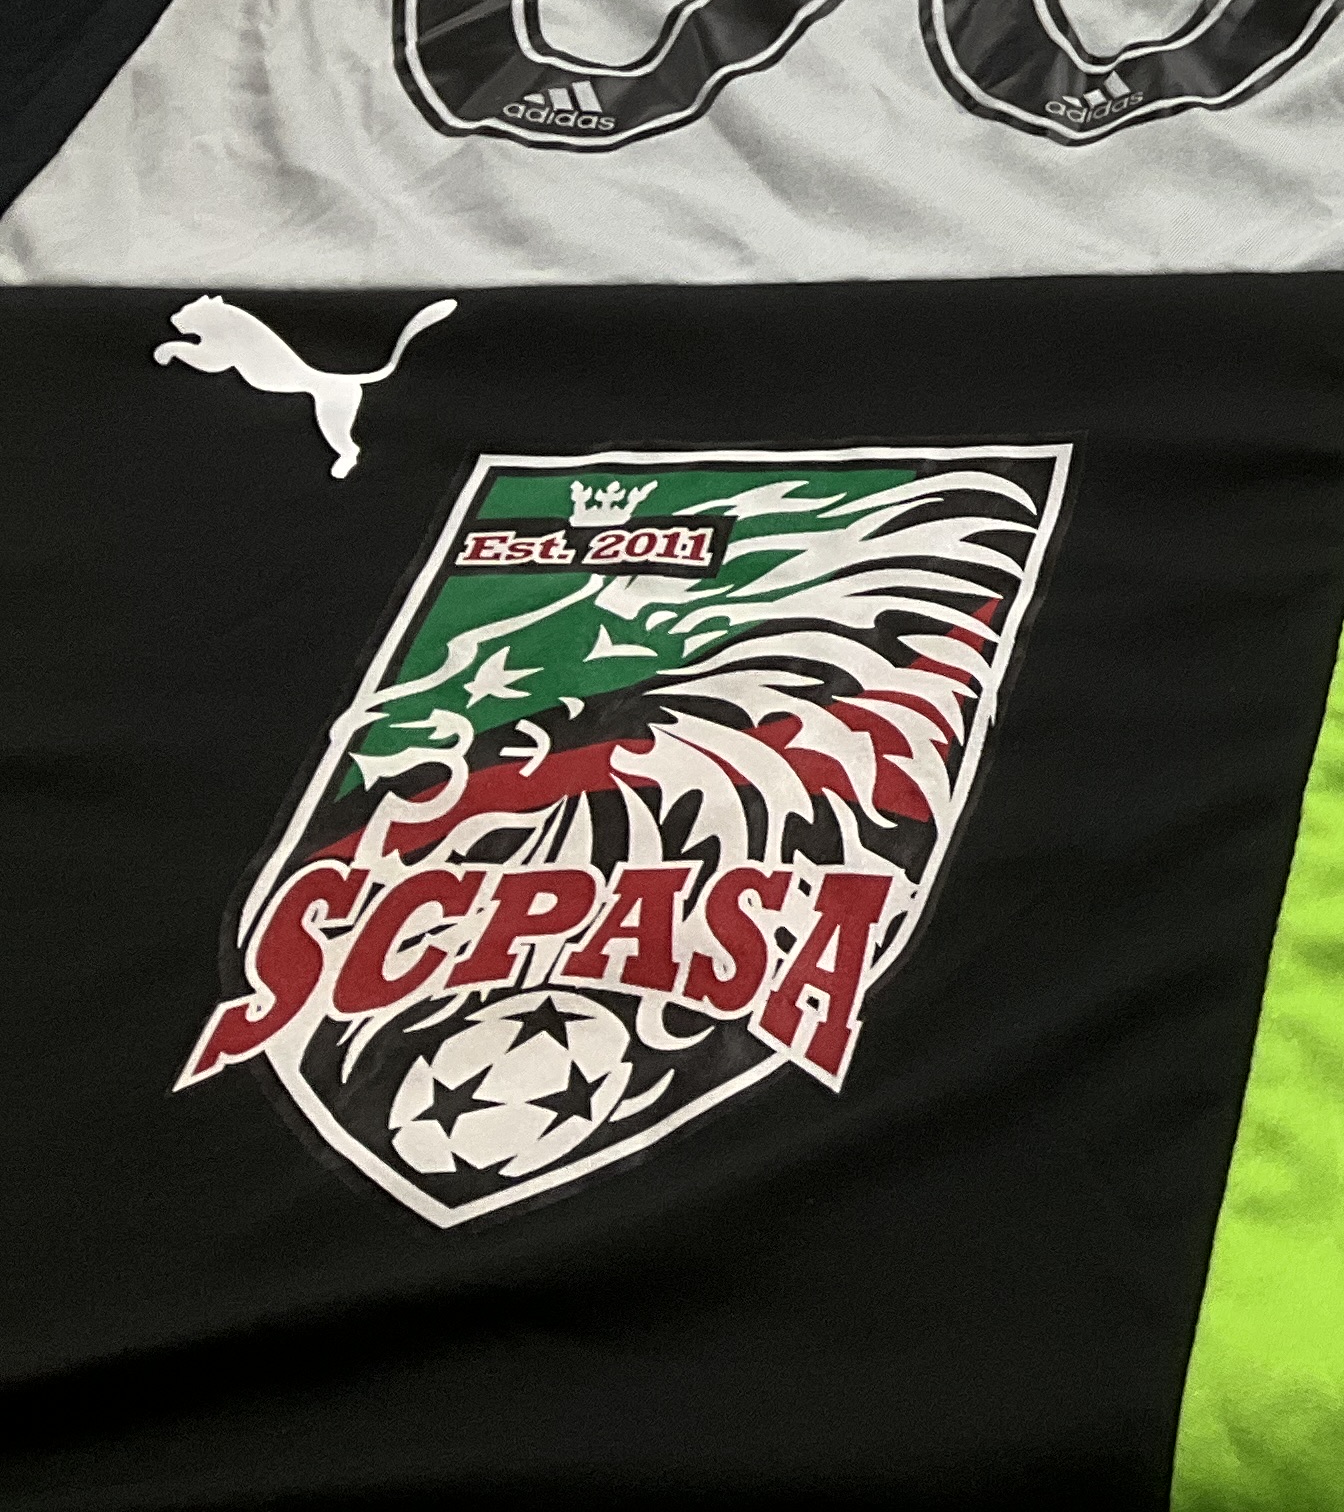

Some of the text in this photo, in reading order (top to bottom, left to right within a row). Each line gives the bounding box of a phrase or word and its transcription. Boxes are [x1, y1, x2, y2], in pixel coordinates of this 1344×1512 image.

[502, 99, 616, 132] adidas
[1044, 87, 1146, 125] adidas
[456, 527, 714, 567] Est. 2011
[172, 853, 910, 1094] SCPASA
